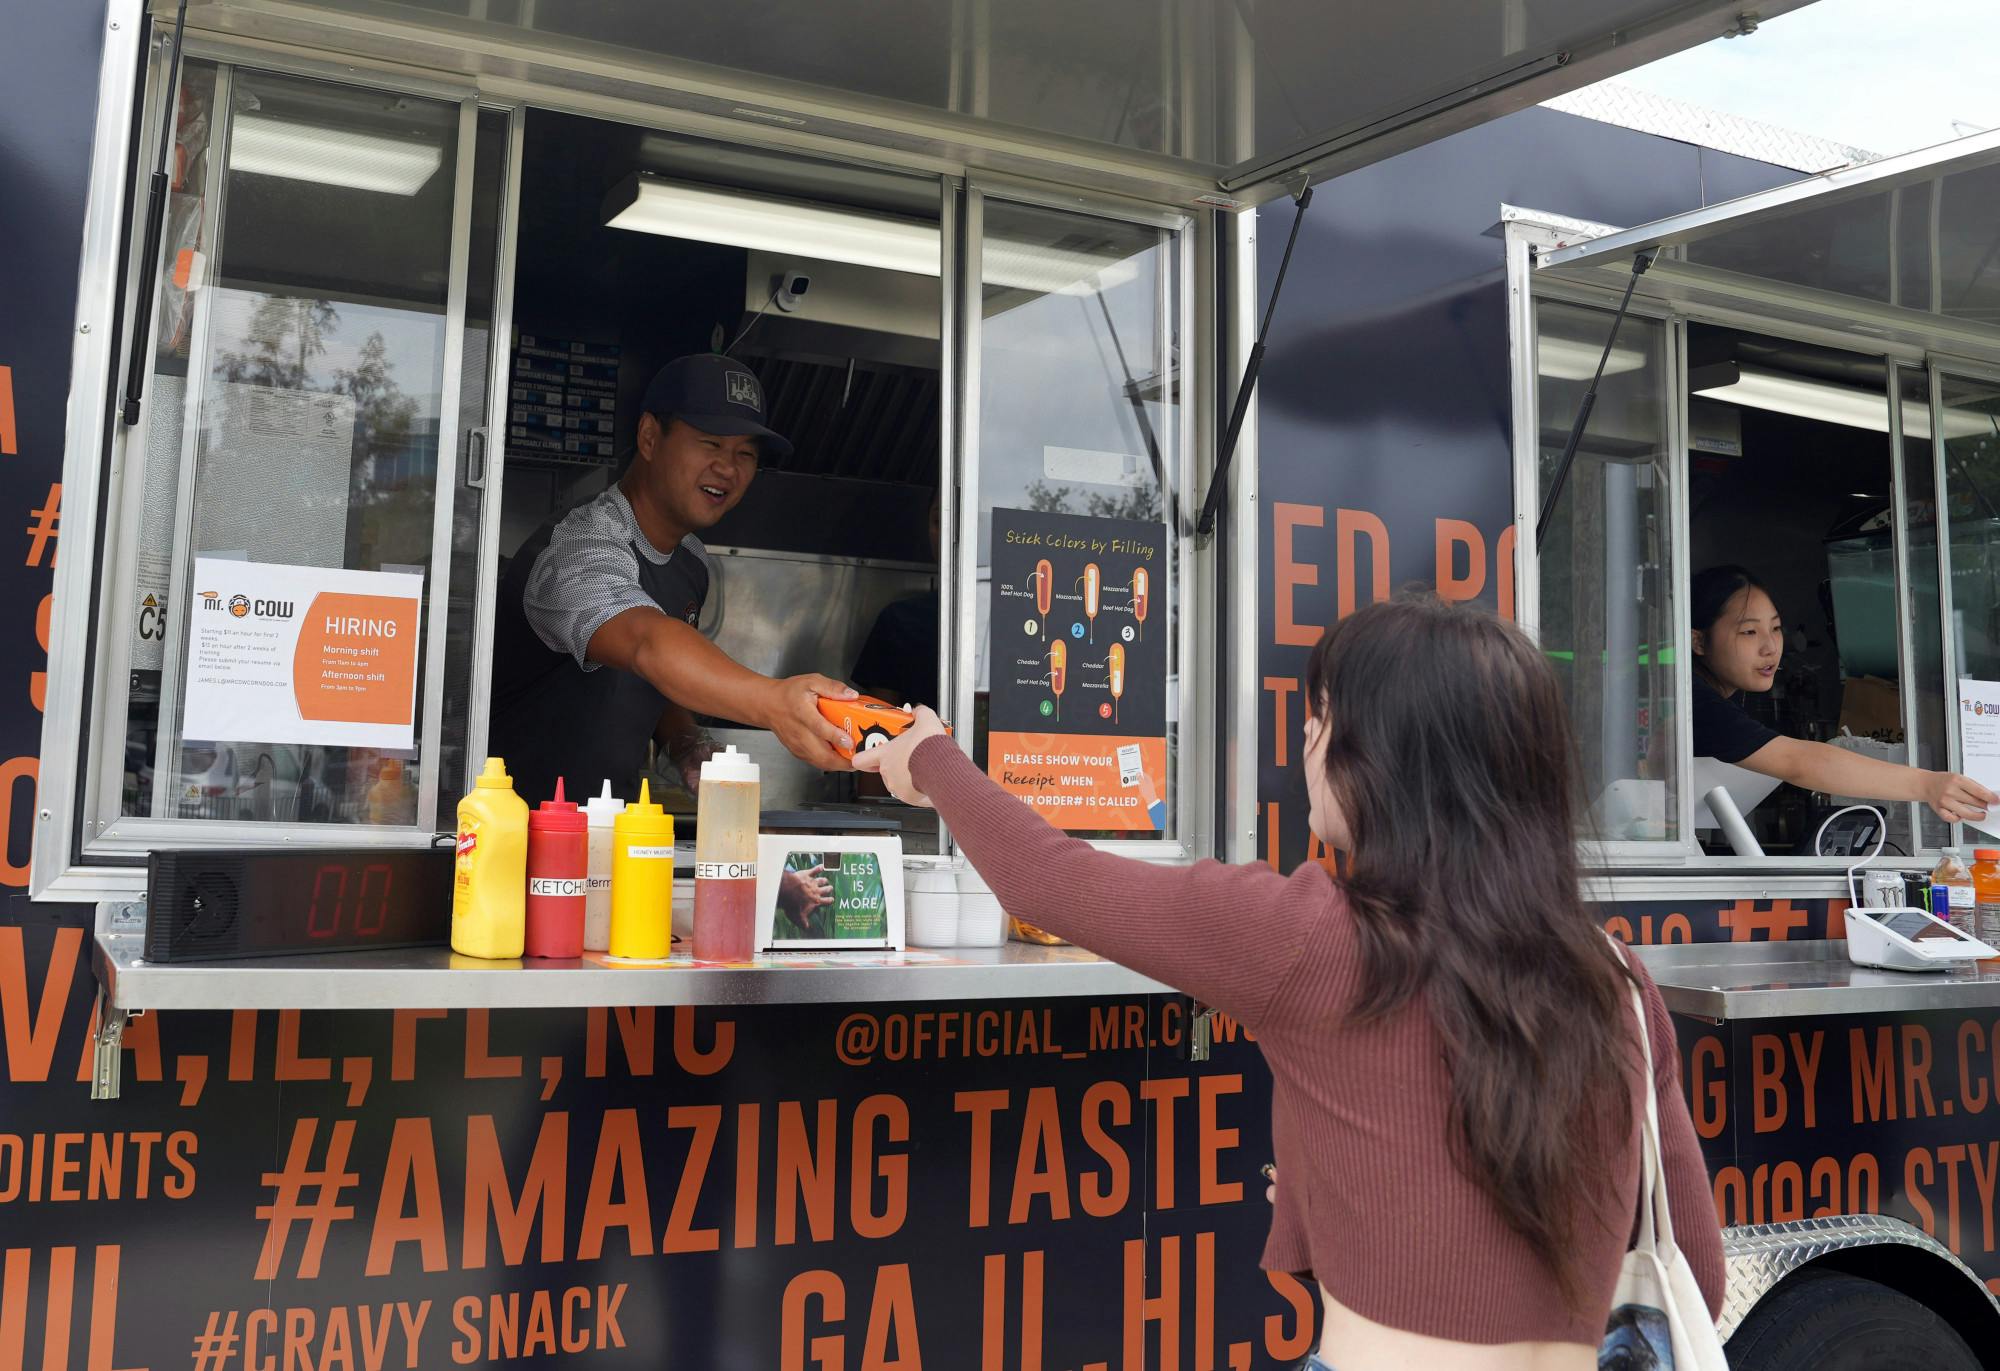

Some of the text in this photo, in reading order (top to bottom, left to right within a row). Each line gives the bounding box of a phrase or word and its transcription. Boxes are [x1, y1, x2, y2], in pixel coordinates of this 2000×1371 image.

[1006, 529, 1154, 560] Stick Colors by Filling
[1023, 592, 1034, 600] Dog
[1056, 593, 1083, 601] Mozzarella
[204, 598, 294, 618] mr. COW
[1102, 604, 1114, 612] Beef
[1124, 606, 1134, 614] Dog
[326, 616, 397, 638] HIRING
[1074, 624, 1082, 635] 2
[1125, 628, 1131, 638] 3
[323, 645, 379, 656] Morning shift
[322, 670, 385, 681] Afternoon shift
[1042, 702, 1049, 714] 4
[1103, 704, 1109, 717] 5
[1984, 704, 2000, 714] COW
[1004, 754, 1112, 766] PLEASE SHOW YOUR
[1003, 771, 1093, 790] Receipt WHEN
[1036, 796, 1082, 806] ORDER#
[1086, 796, 1096, 806] IS
[1098, 796, 1138, 806] CALLED
[696, 864, 726, 877] EET
[843, 864, 873, 875] LESS
[853, 881, 864, 892] IS
[306, 864, 392, 938] 00
[839, 898, 877, 909] MORE
[1752, 1030, 1825, 1134] BY
[253, 1074, 1244, 1281] #AMAZING TASTE
[192, 1284, 628, 1371] #CRAVY SNACK
